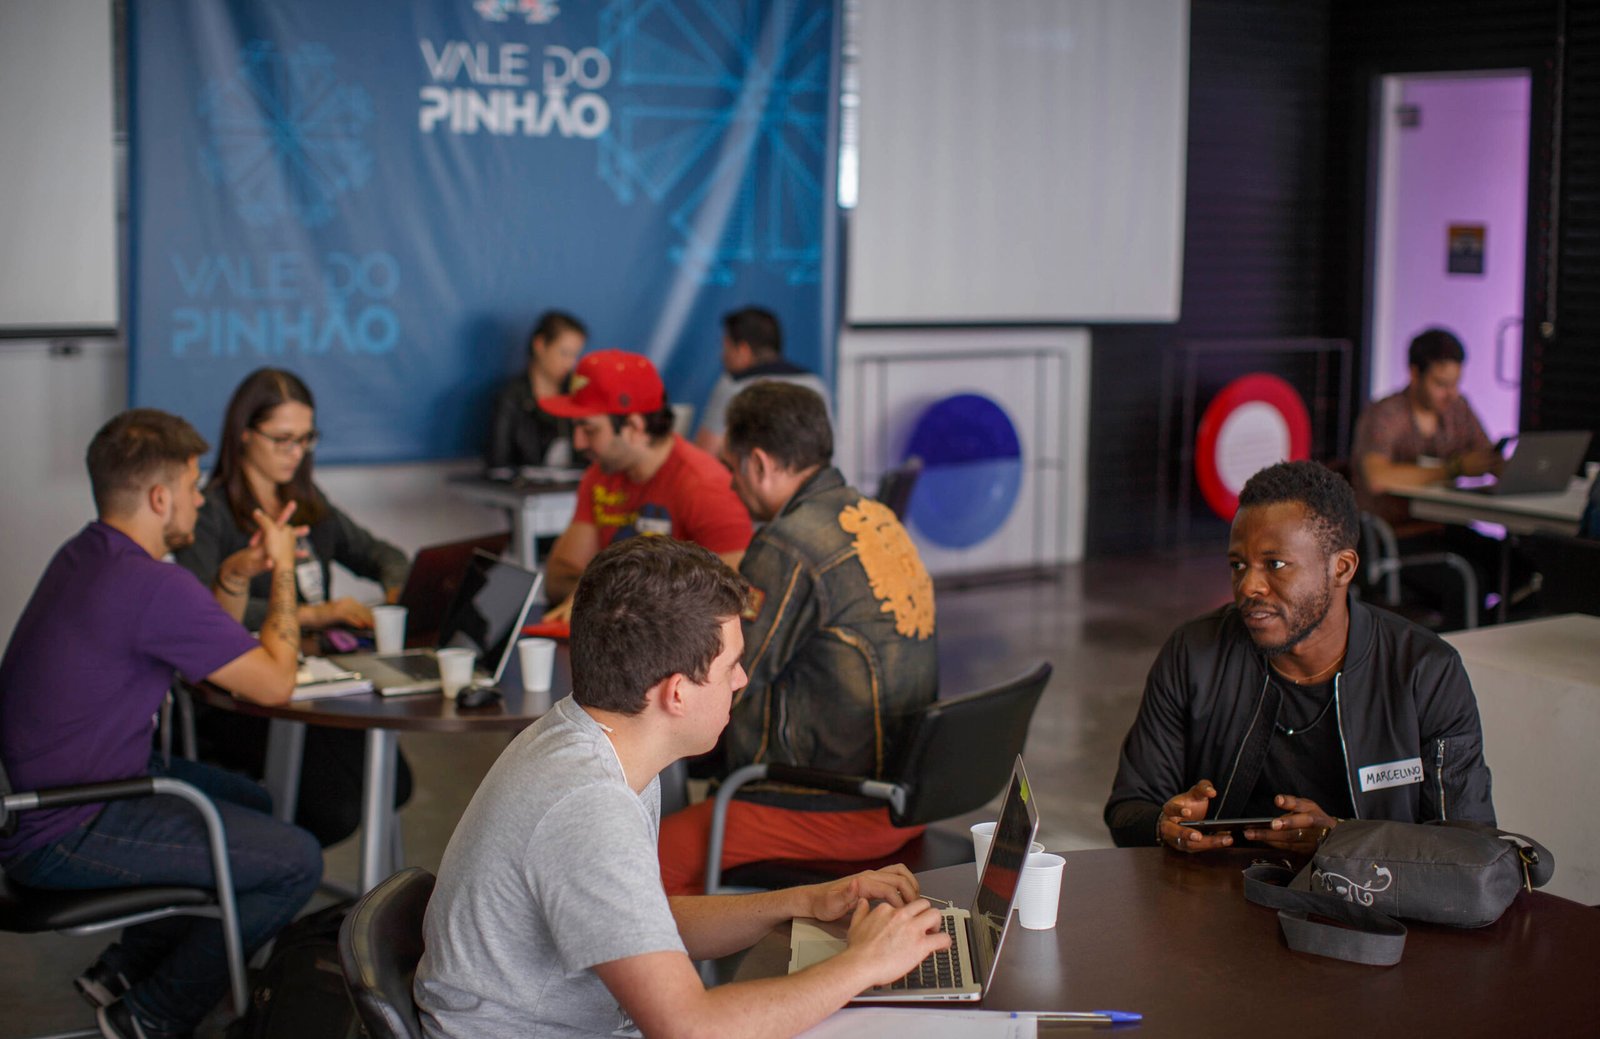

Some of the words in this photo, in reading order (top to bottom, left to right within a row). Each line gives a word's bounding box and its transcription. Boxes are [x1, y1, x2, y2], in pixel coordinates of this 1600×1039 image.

[420, 39, 529, 85] VALE
[543, 45, 611, 89] DO
[419, 84, 610, 139] PINHÃO
[171, 252, 300, 298] VALE
[323, 250, 400, 298] DO
[171, 297, 400, 358] PINHÃO
[1366, 765, 1421, 784] MARCELINO
